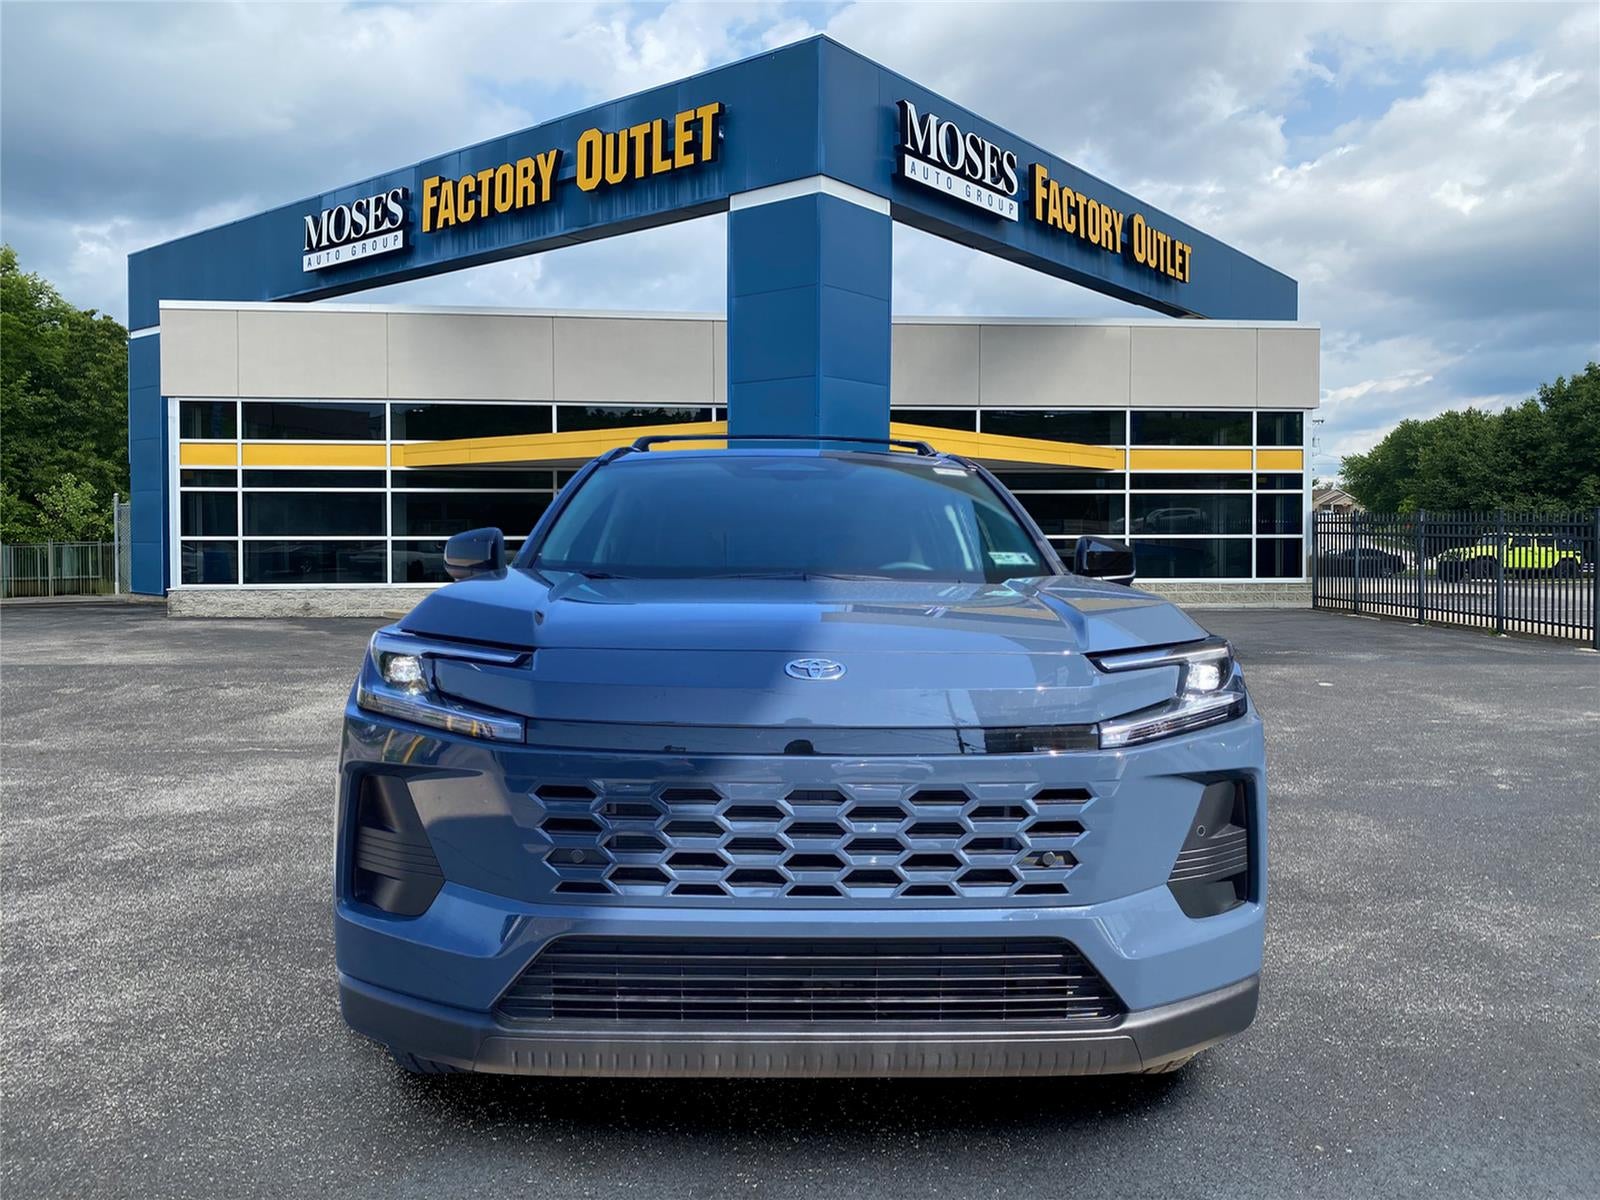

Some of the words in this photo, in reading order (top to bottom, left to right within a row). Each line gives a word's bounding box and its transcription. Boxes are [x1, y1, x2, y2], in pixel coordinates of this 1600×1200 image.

[422, 148, 559, 233] FACTORY
[576, 102, 720, 192] OUTLET
[904, 100, 1018, 196] MOSES
[910, 161, 952, 190] AUTO
[965, 184, 1014, 215] GROUP
[303, 187, 404, 251] MOSES
[307, 249, 340, 268] AUTO
[351, 234, 399, 257] GROUP
[1034, 163, 1124, 254] FACTORY
[1132, 212, 1192, 283] OUTLET
